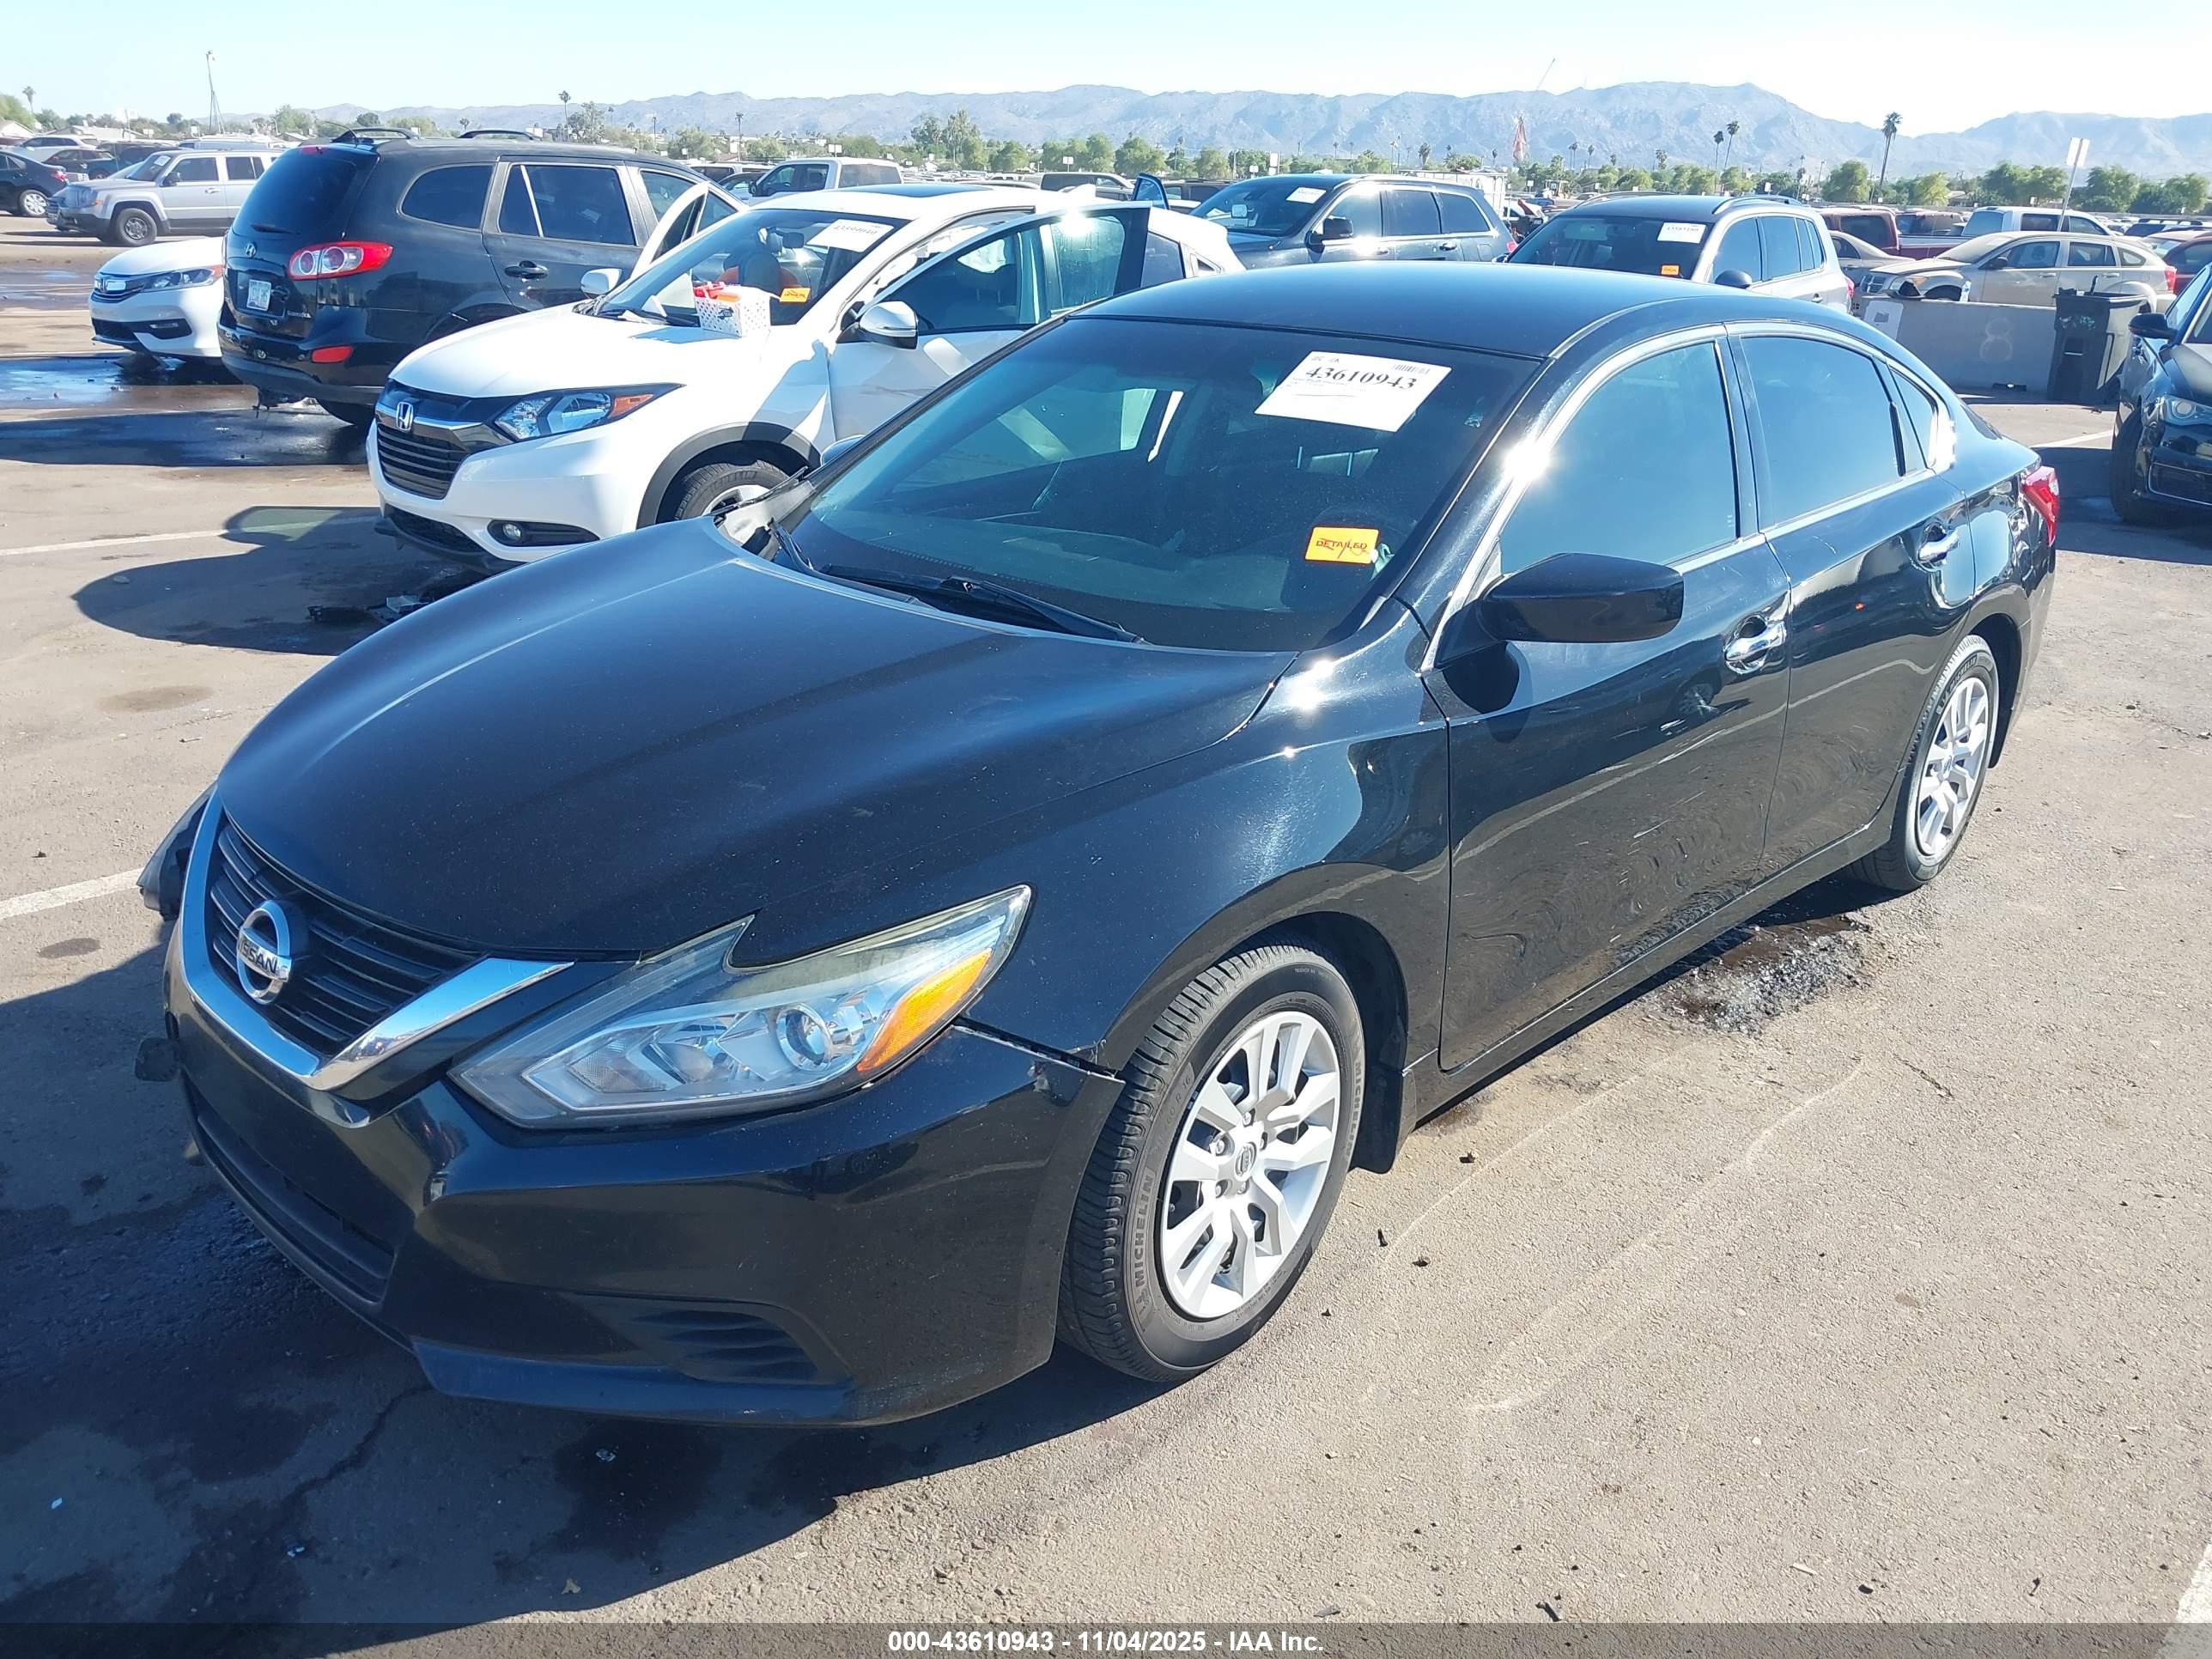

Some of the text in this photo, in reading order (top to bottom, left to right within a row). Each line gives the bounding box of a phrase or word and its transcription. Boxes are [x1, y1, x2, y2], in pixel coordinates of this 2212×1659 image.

[1305, 366, 1418, 390] 43610943
[1345, 1061, 1363, 1157] MICHELIN
[1133, 1174, 1154, 1288] MICHELIN
